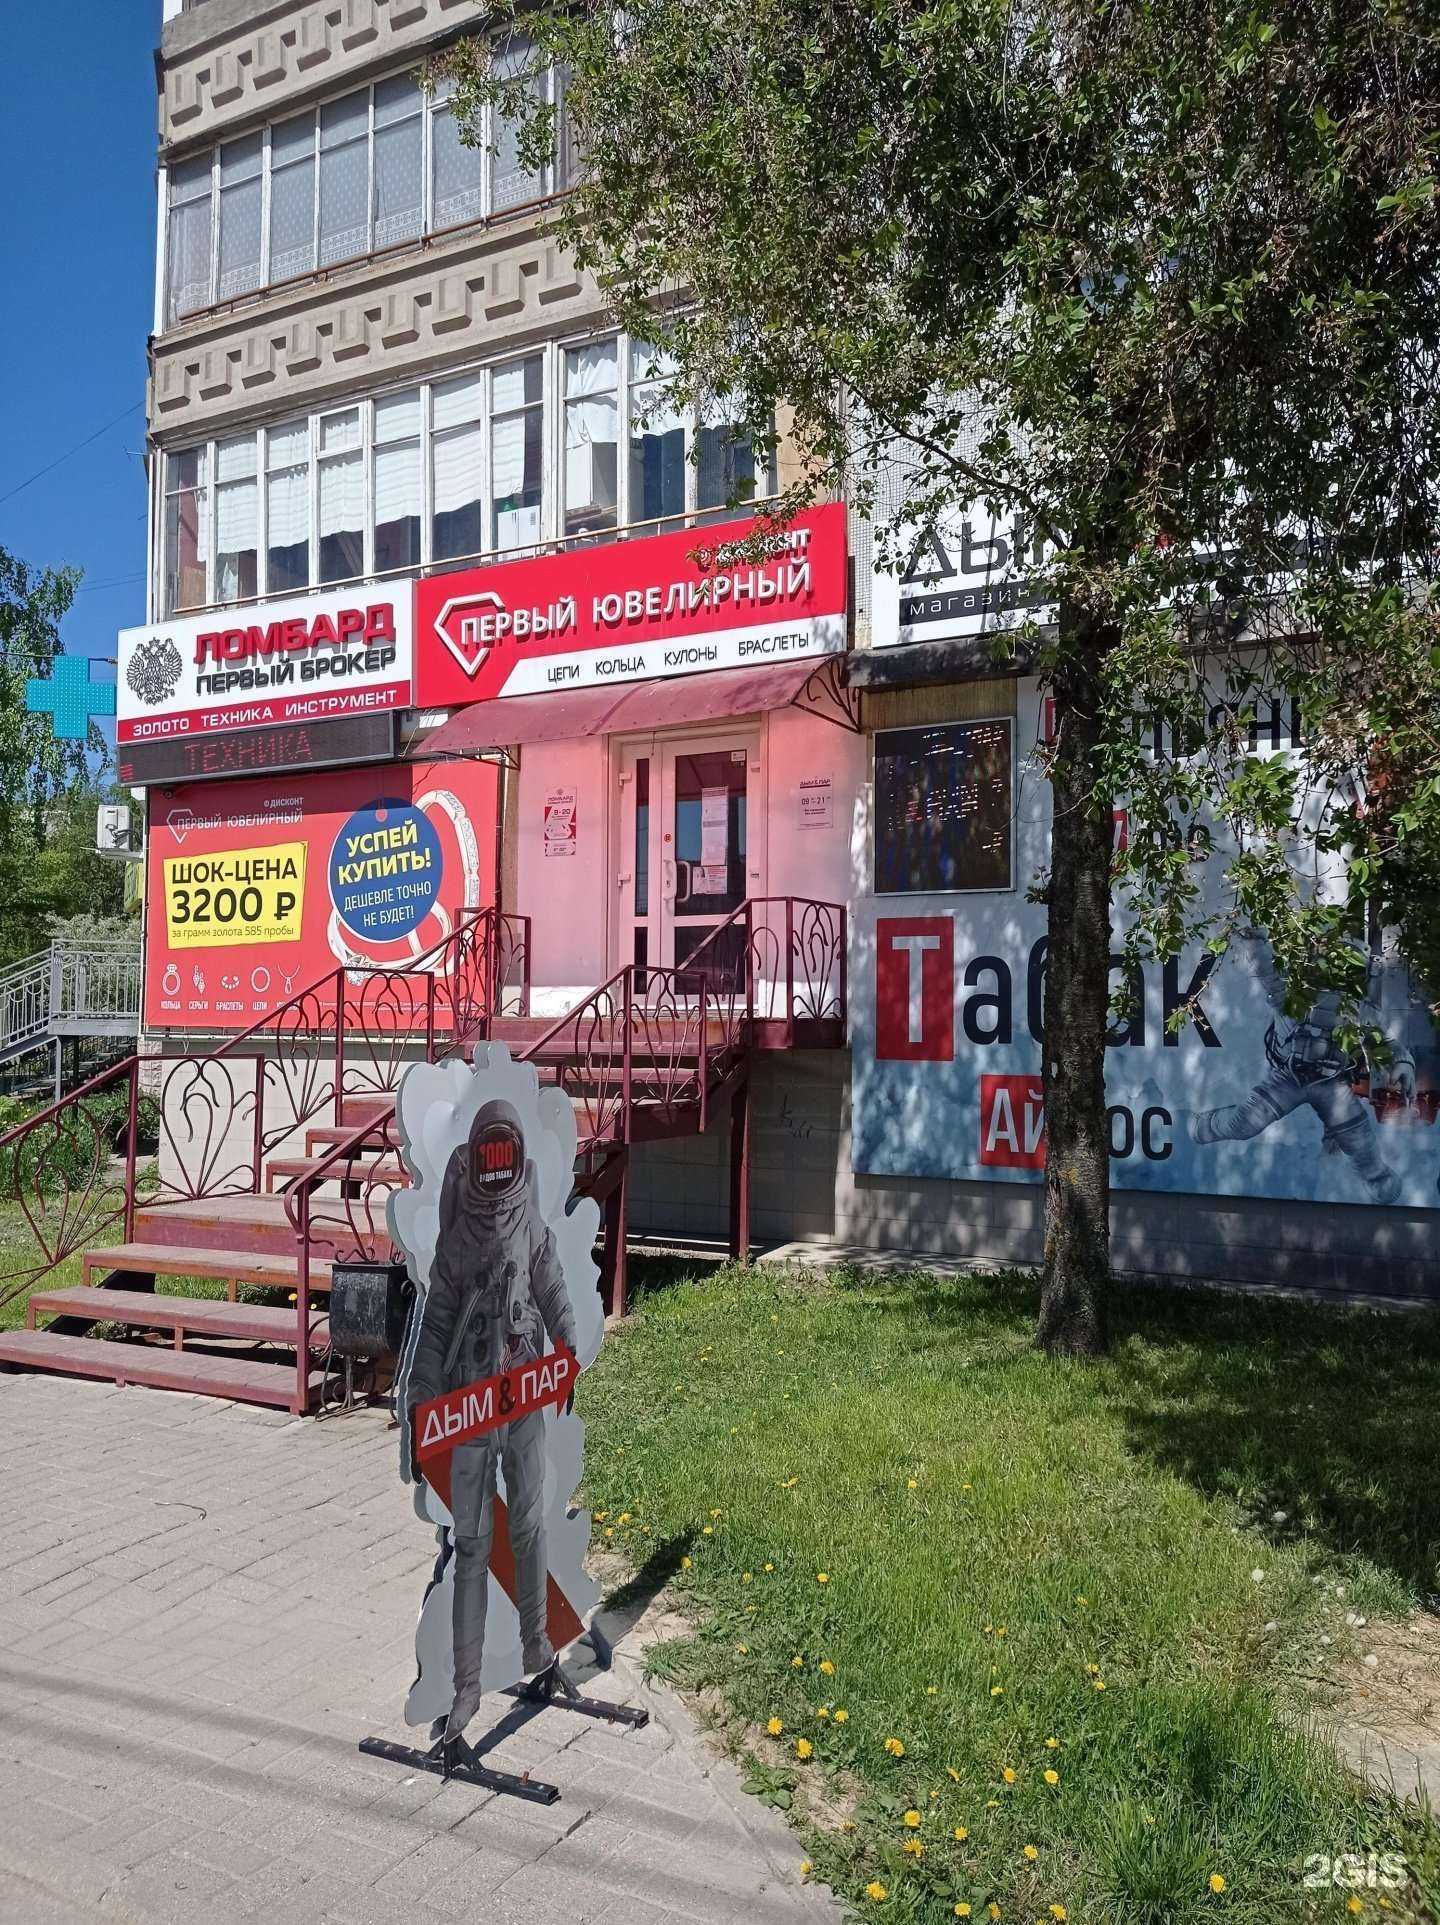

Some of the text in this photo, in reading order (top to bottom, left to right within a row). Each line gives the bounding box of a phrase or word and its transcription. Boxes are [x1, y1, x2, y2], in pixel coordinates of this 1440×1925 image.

[459, 556, 812, 645] ПЕРВЫЙ ЮВЕЛИРНЫЙ
[910, 587, 1030, 616] магазин
[192, 602, 396, 666] ЛОМБАРД
[197, 646, 396, 695] ПЕРВЫЙ БРОКЕР
[547, 632, 810, 684] ЦЕПИ КОЛЬЦА КУЛОНЫ БРАСЛЕТЫ
[133, 689, 397, 737] ЗОЛОТО ТЕХНИКА ИНСТРУМЕНТ
[184, 729, 313, 773] ТЕХНИКА
[177, 808, 303, 830] ПЕРВЫЙ ЮВЕЛИРНЫЙ
[270, 797, 304, 809] ДИСКОНТ
[346, 820, 419, 858] УСПЕЙ
[172, 858, 298, 885] ШОК-ЦЕНА
[338, 847, 432, 886] КУПИТЬ!
[171, 886, 264, 924] 3200
[343, 881, 432, 913] ДЕШЕВЛЕ ТОЧНО
[172, 925, 294, 939] за грамм золота 585 пробы
[363, 906, 414, 927] НЕ БУДЕТ!
[188, 1000, 209, 1010] СЕРЬГИ
[215, 1001, 244, 1011] БРАСЛЕТЫ
[252, 1000, 268, 1010] ЦЕПИ
[479, 1141, 513, 1168] 1000
[420, 1357, 570, 1448] ДЫМ & ПАР
